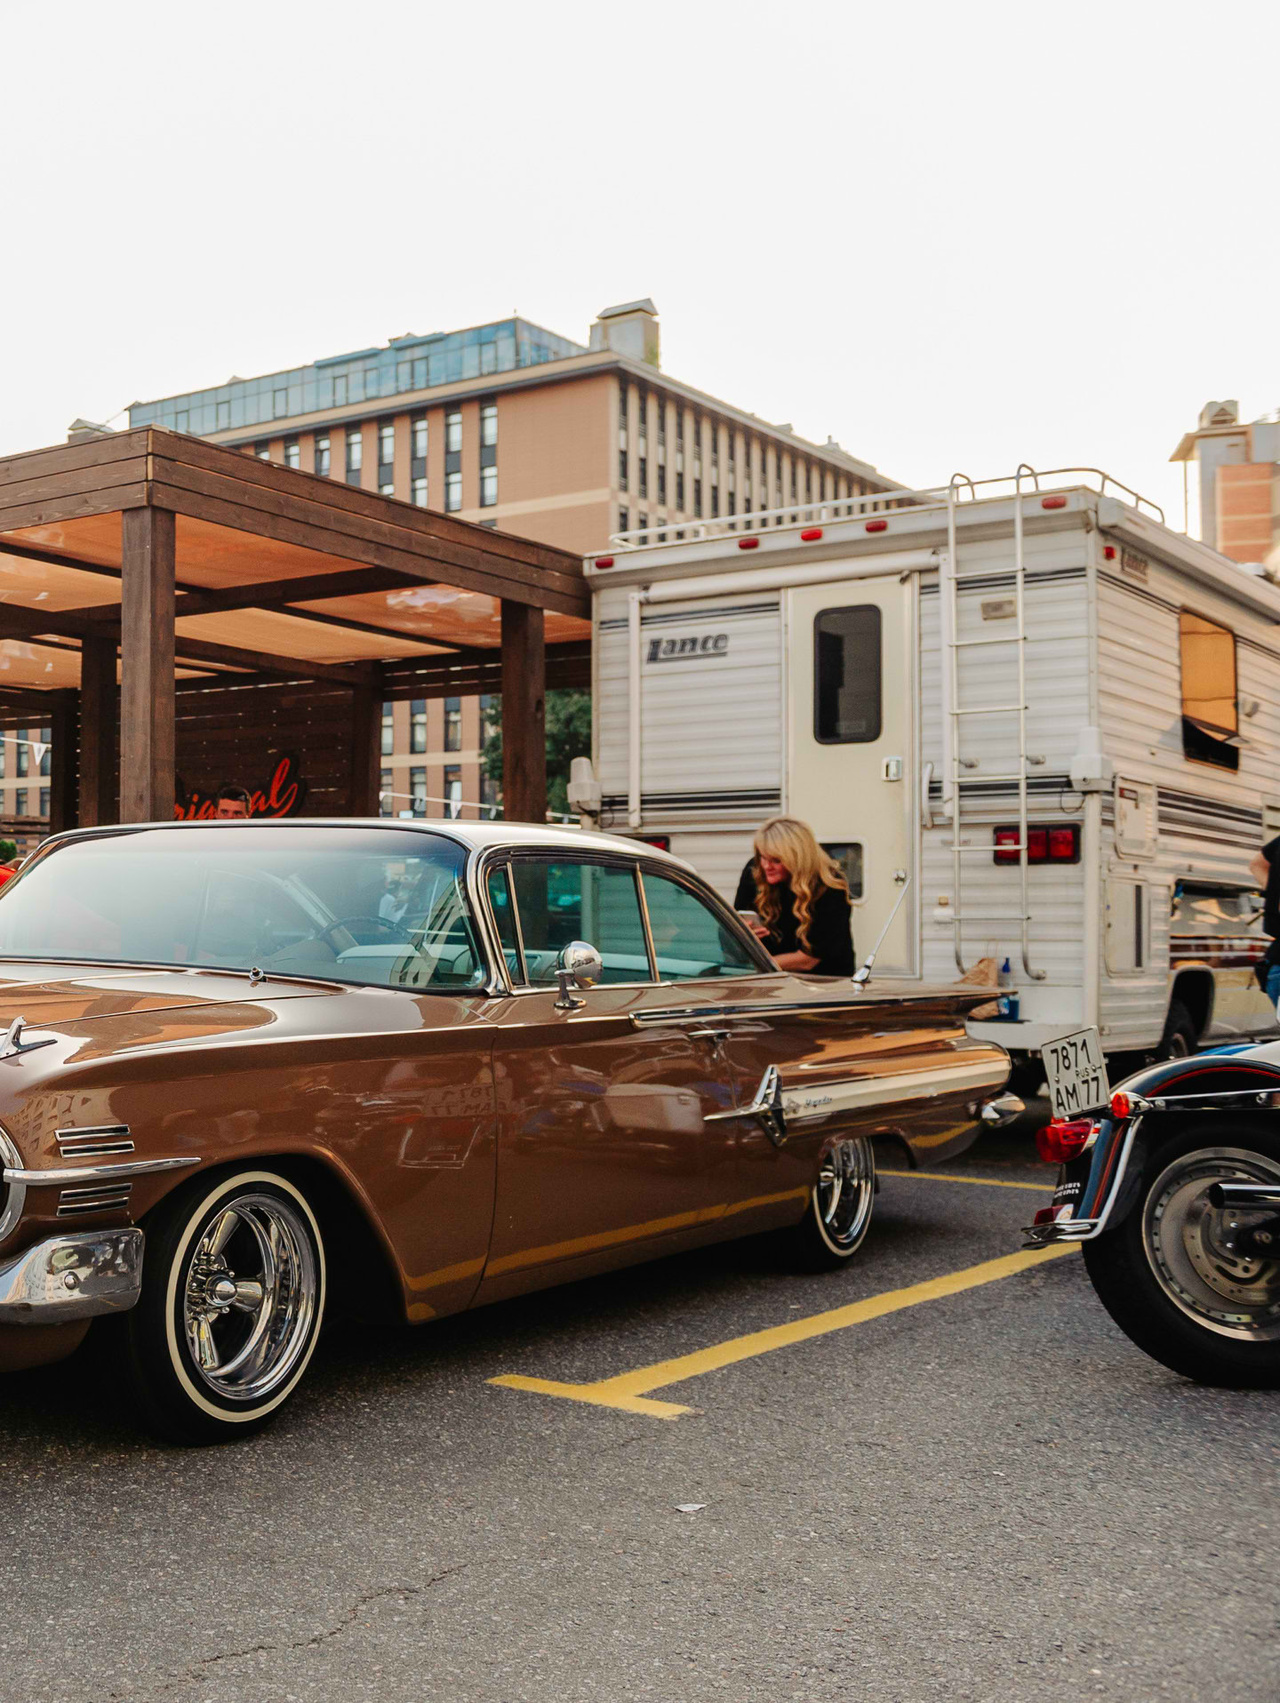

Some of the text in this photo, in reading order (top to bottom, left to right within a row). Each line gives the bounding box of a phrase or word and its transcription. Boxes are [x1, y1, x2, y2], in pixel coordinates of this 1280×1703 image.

[647, 633, 729, 663] Lance
[174, 758, 298, 820] rigal
[1050, 1038, 1091, 1075] 7871
[1075, 1067, 1090, 1079] RUS
[1055, 1076, 1100, 1112] AM 77
